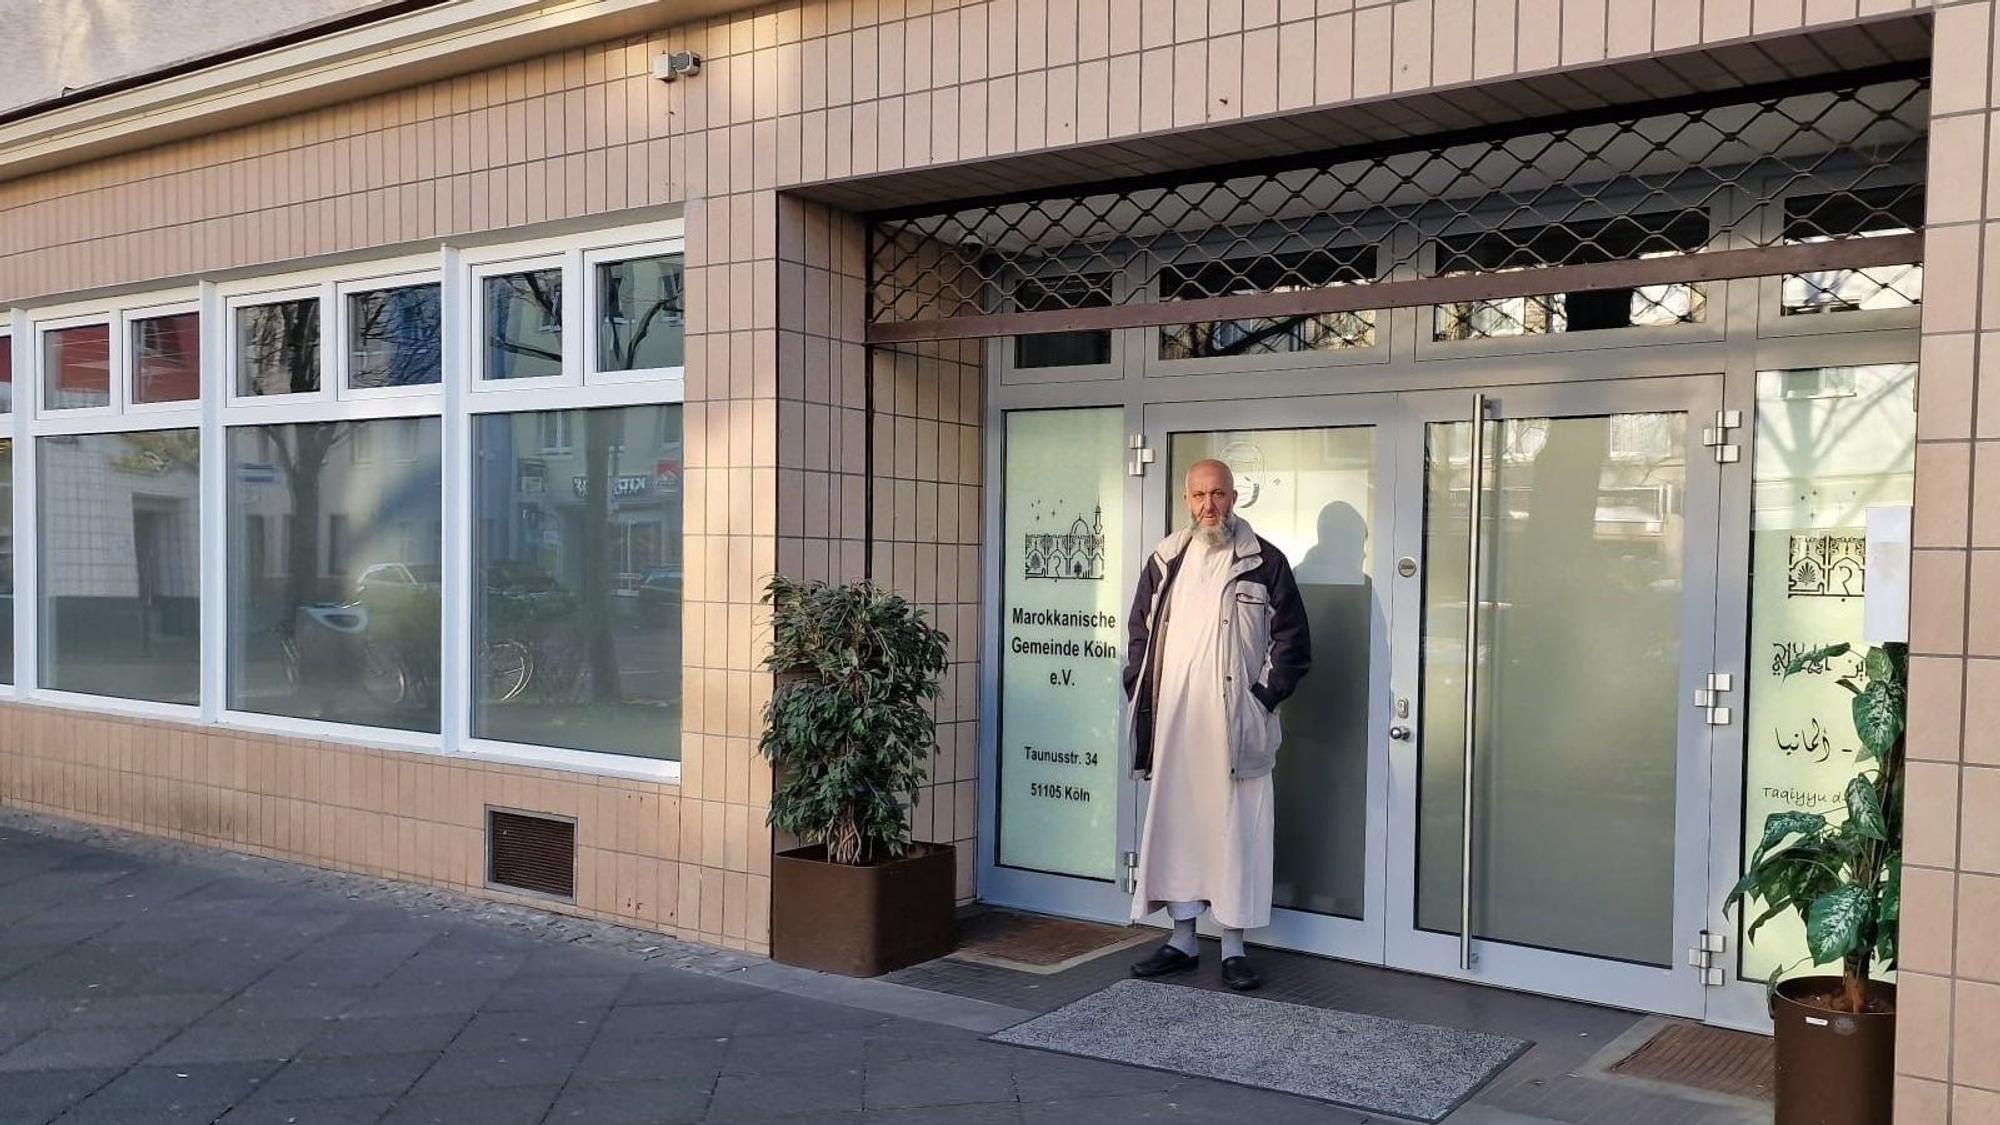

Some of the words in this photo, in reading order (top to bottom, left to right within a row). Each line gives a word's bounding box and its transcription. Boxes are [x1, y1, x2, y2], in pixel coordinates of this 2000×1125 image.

[1012, 607, 1116, 628] Marokkanische
[1012, 636, 1080, 656] Gemeinde
[1084, 640, 1116, 658] Köln
[1050, 669, 1075, 686] e.V.
[1024, 746, 1082, 765] Taunusstr.
[1085, 751, 1098, 767] 34
[1031, 783, 1062, 798] 51105
[1065, 786, 1090, 802] Köln
[1763, 787, 1827, 807] Taqiyyu
